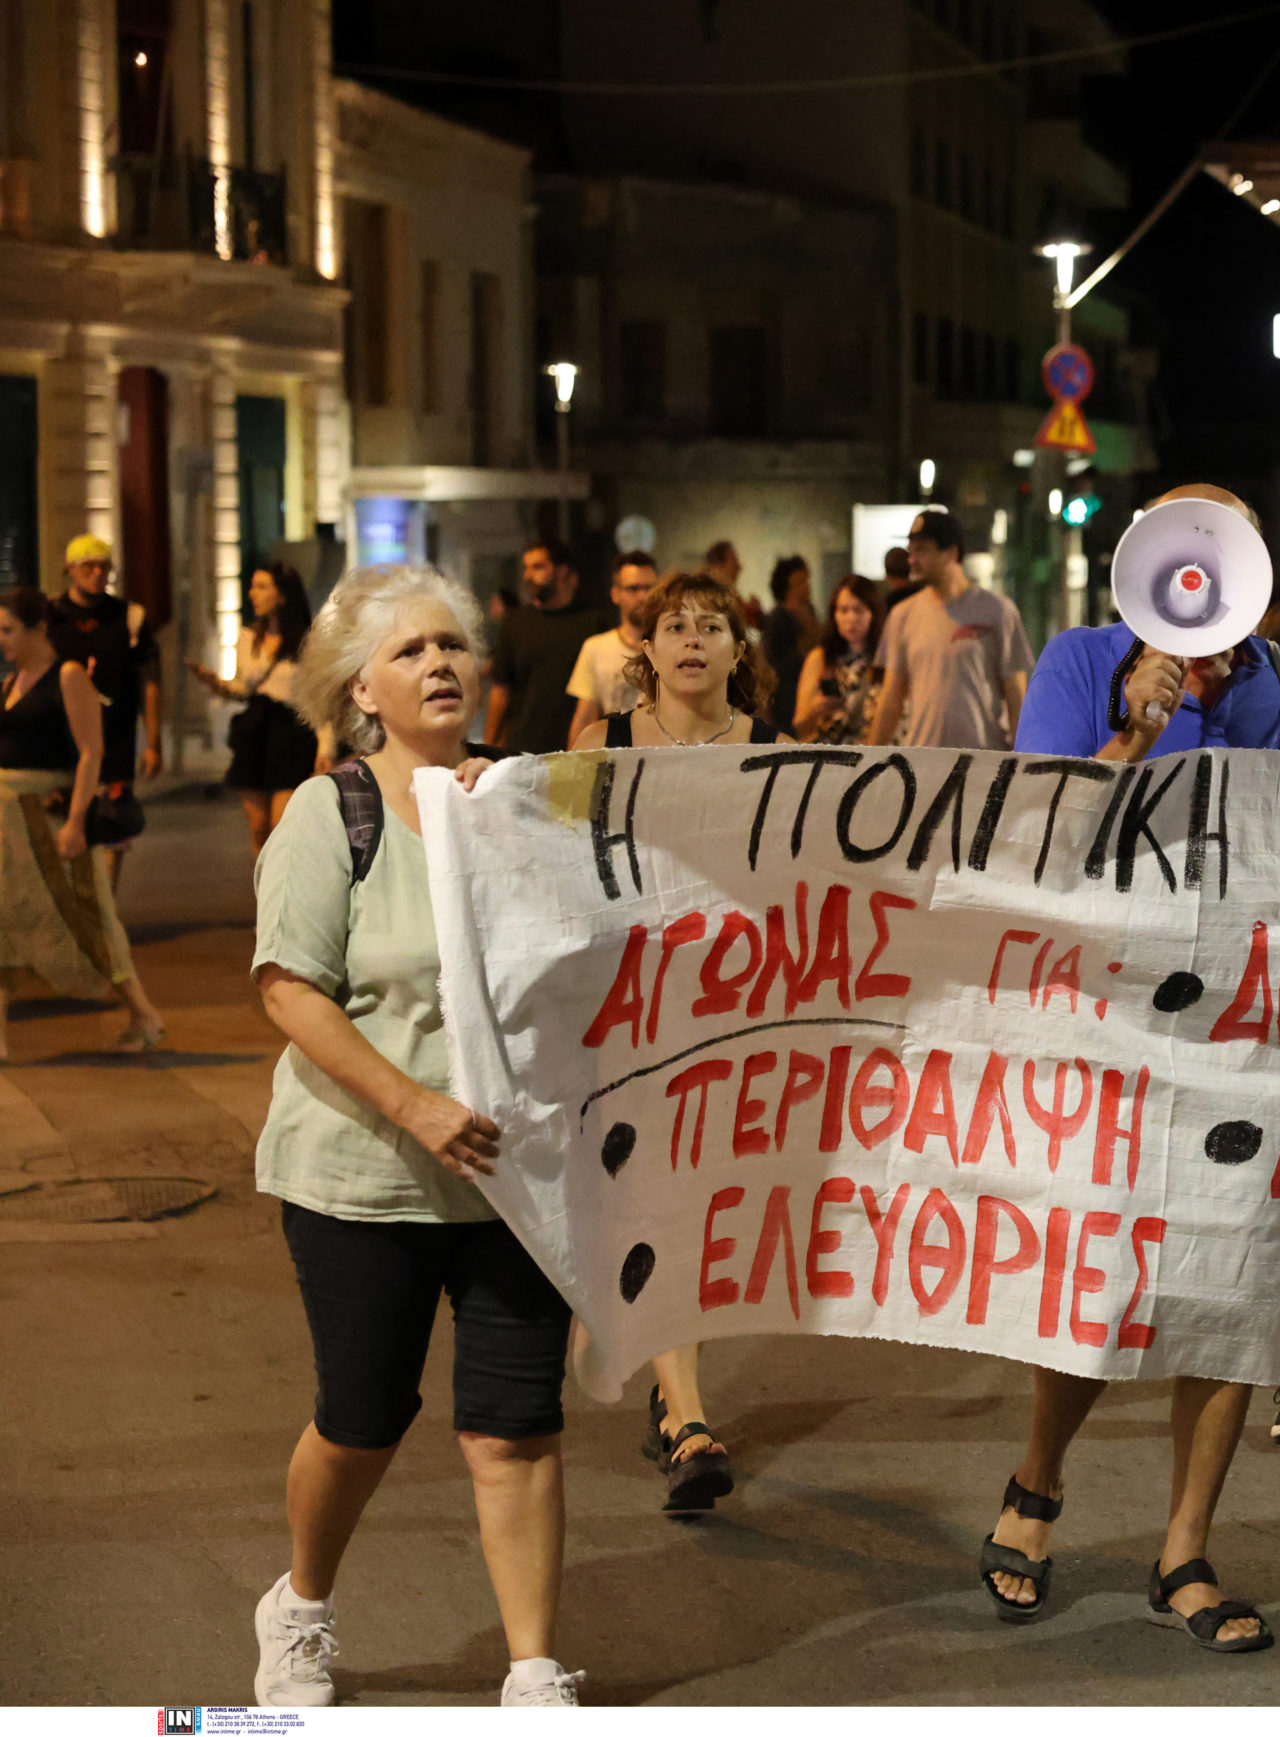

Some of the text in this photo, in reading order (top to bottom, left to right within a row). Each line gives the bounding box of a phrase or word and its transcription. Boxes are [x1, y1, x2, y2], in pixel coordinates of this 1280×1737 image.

[590, 757, 645, 900] Η
[740, 750, 1229, 901] ΠΟΛΙΤΙΚΗ
[581, 880, 918, 1049] ΑΓΩΝΑΣ
[665, 1044, 1151, 1193] ΠΕΡΙΘΑΛΨΗ
[699, 1176, 1168, 1350] ΕΛΕΥΘΡΙΕΣ
